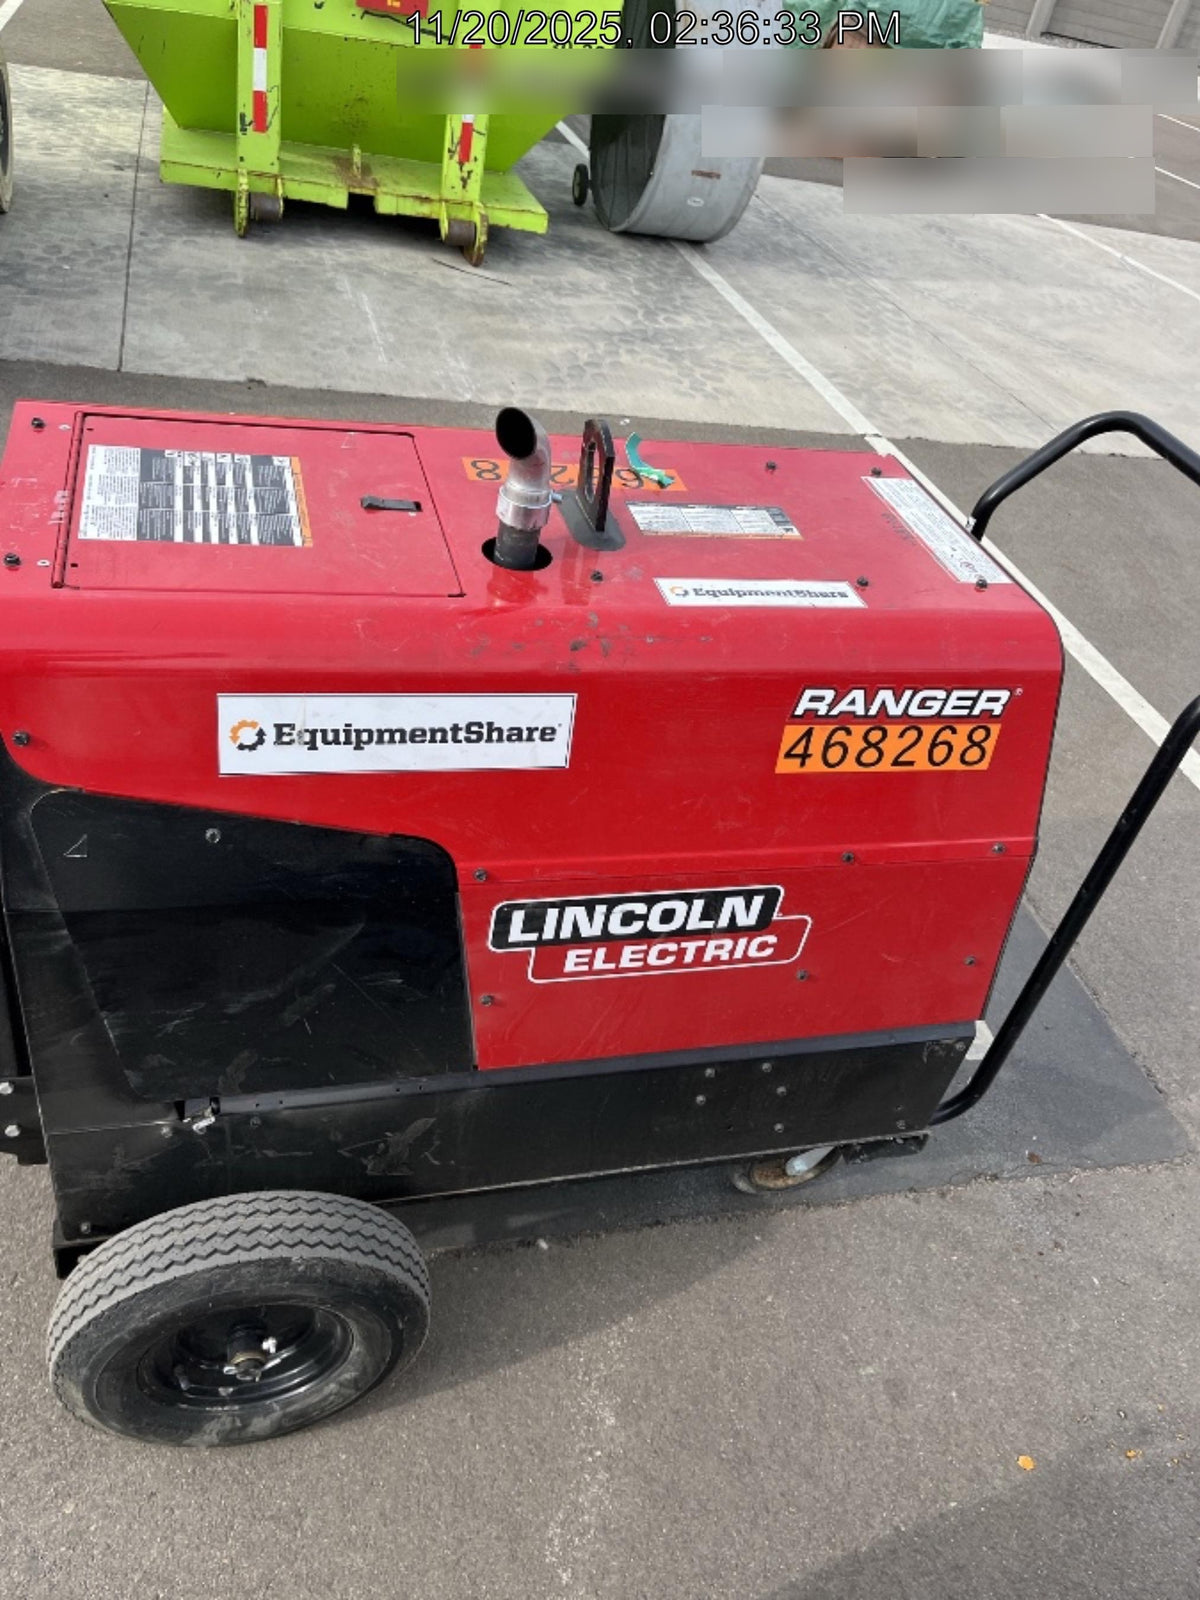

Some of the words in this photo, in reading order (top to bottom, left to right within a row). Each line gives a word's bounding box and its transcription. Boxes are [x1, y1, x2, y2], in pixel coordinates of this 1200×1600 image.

[273, 721, 557, 751] EquipmentShare
[783, 725, 992, 769] 468268
[508, 896, 765, 942] LINCOLN
[563, 935, 777, 972] ELECTRIC
